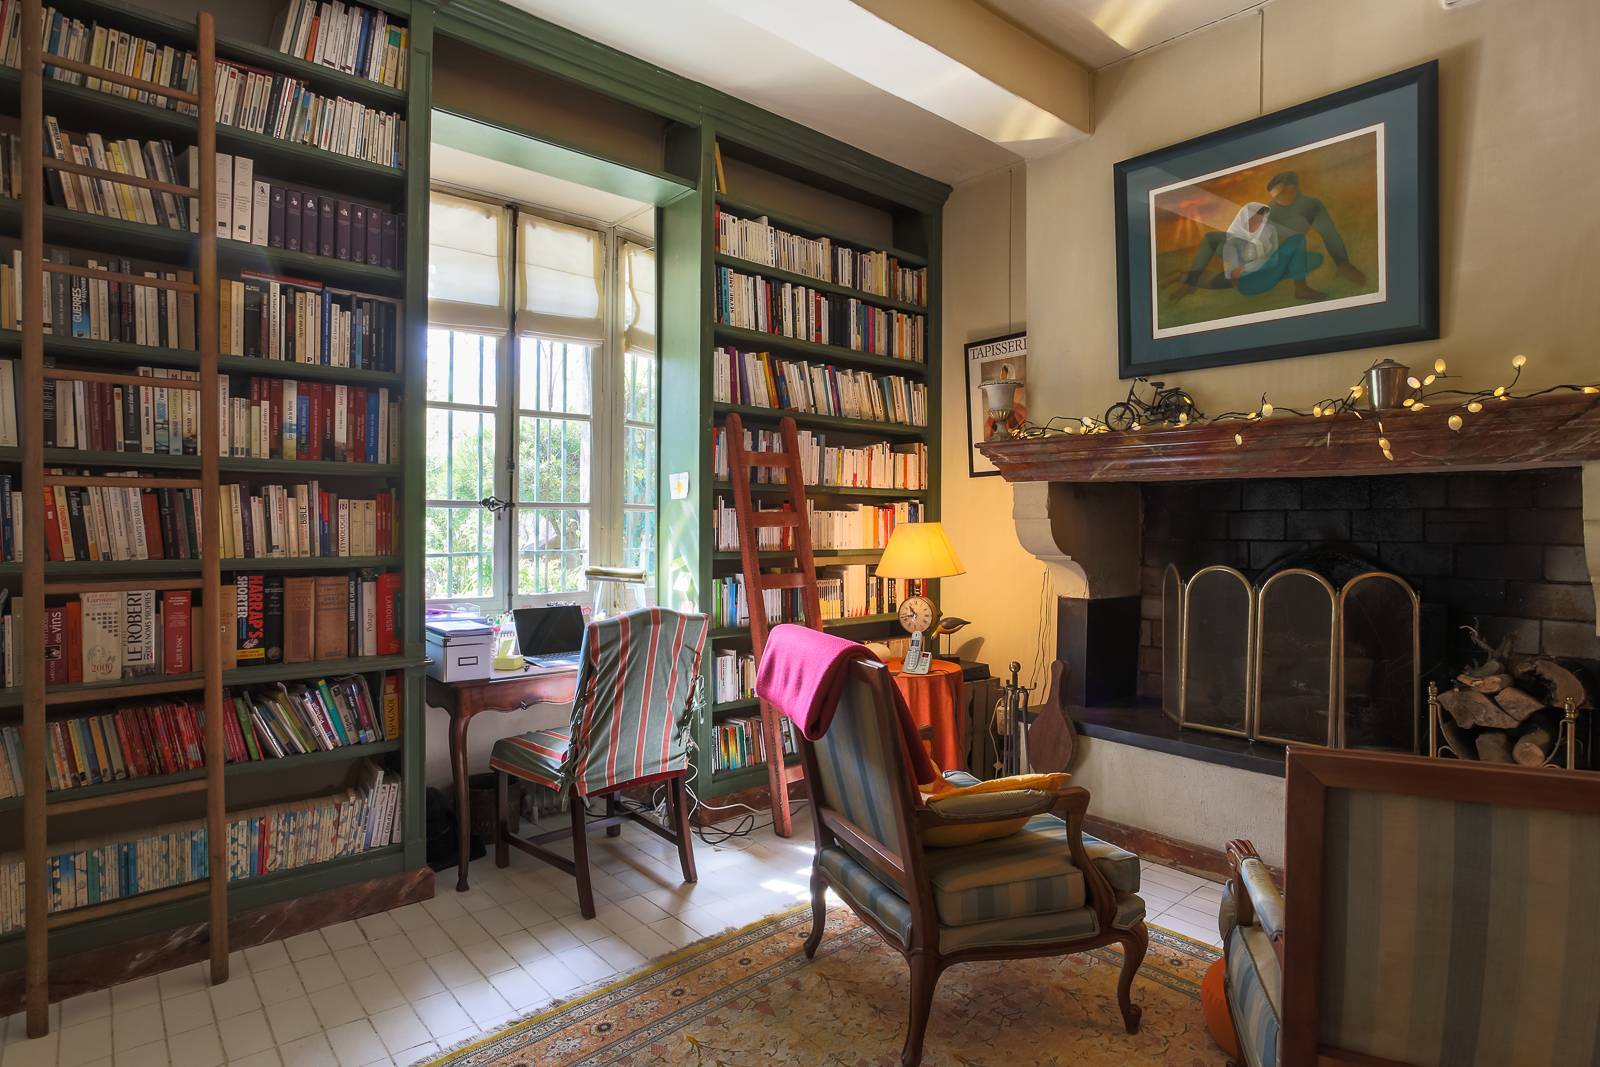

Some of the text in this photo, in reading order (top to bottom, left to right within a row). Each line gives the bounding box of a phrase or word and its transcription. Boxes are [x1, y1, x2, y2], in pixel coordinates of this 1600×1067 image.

[72, 287, 82, 323] GUERRES
[970, 338, 1027, 360] TAPISSERI
[237, 575, 248, 618] SHORTER
[248, 575, 265, 639] HARRAP'S
[386, 595, 394, 633] LAROUSSE
[50, 611, 62, 633] vins
[127, 591, 143, 662] LE ROBERT
[144, 620, 153, 640] NOMS
